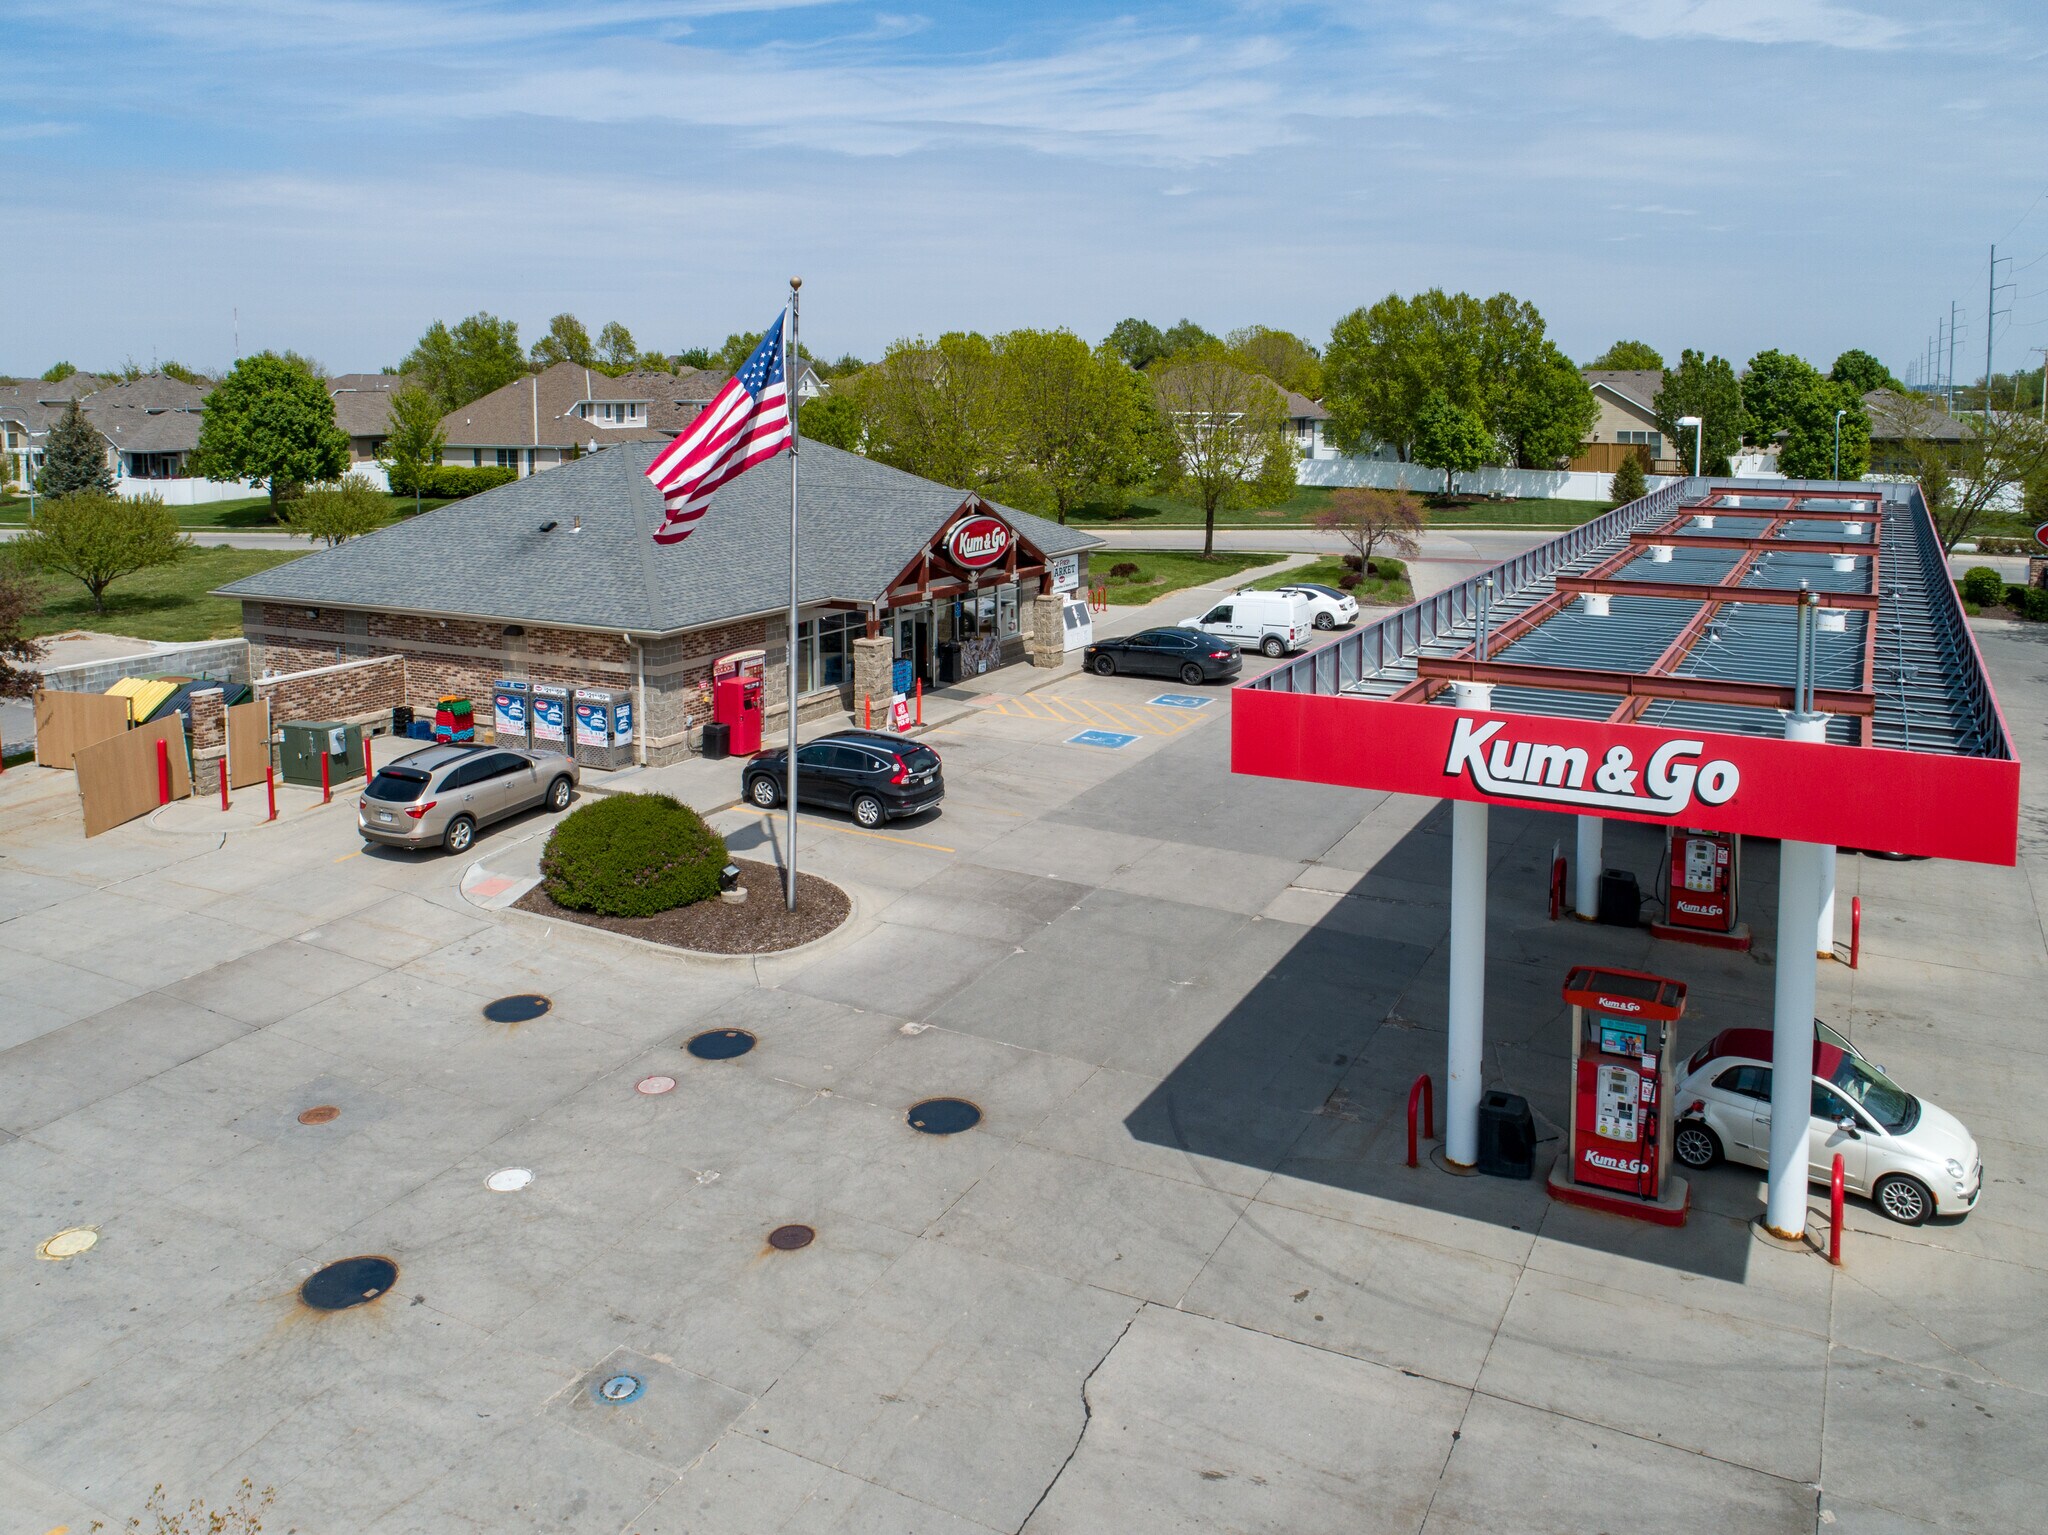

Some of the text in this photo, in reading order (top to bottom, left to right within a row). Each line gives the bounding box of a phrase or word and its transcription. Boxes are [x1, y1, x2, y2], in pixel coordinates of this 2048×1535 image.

[959, 527, 1005, 556] Kum & Go
[1054, 565, 1076, 577] ARKET
[1444, 717, 1741, 816] Kum & Go
[1677, 900, 1723, 916] Kum & Go
[1599, 998, 1641, 1011] Kum & Go
[1585, 1149, 1649, 1174] Kum & Go
